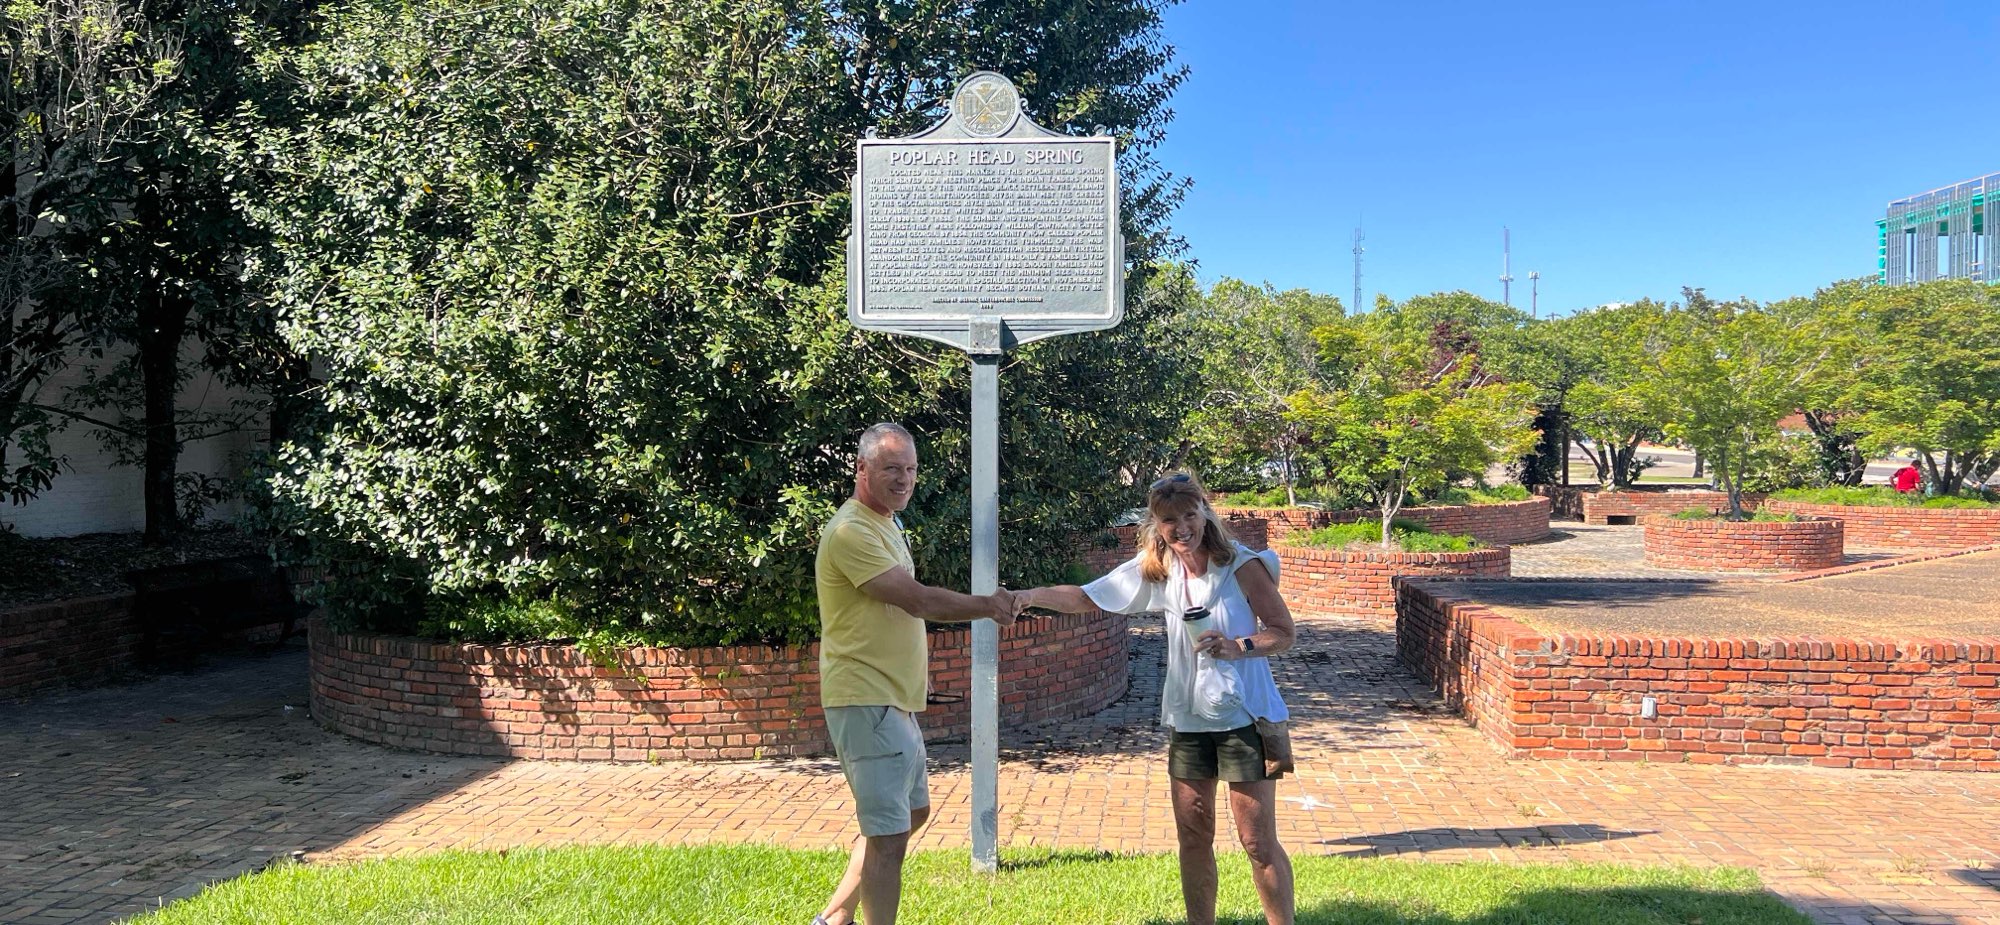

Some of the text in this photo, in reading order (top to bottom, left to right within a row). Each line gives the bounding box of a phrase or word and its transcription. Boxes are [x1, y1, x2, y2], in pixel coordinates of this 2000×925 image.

[890, 149, 1083, 166] POPLAR HEAD SPRING
